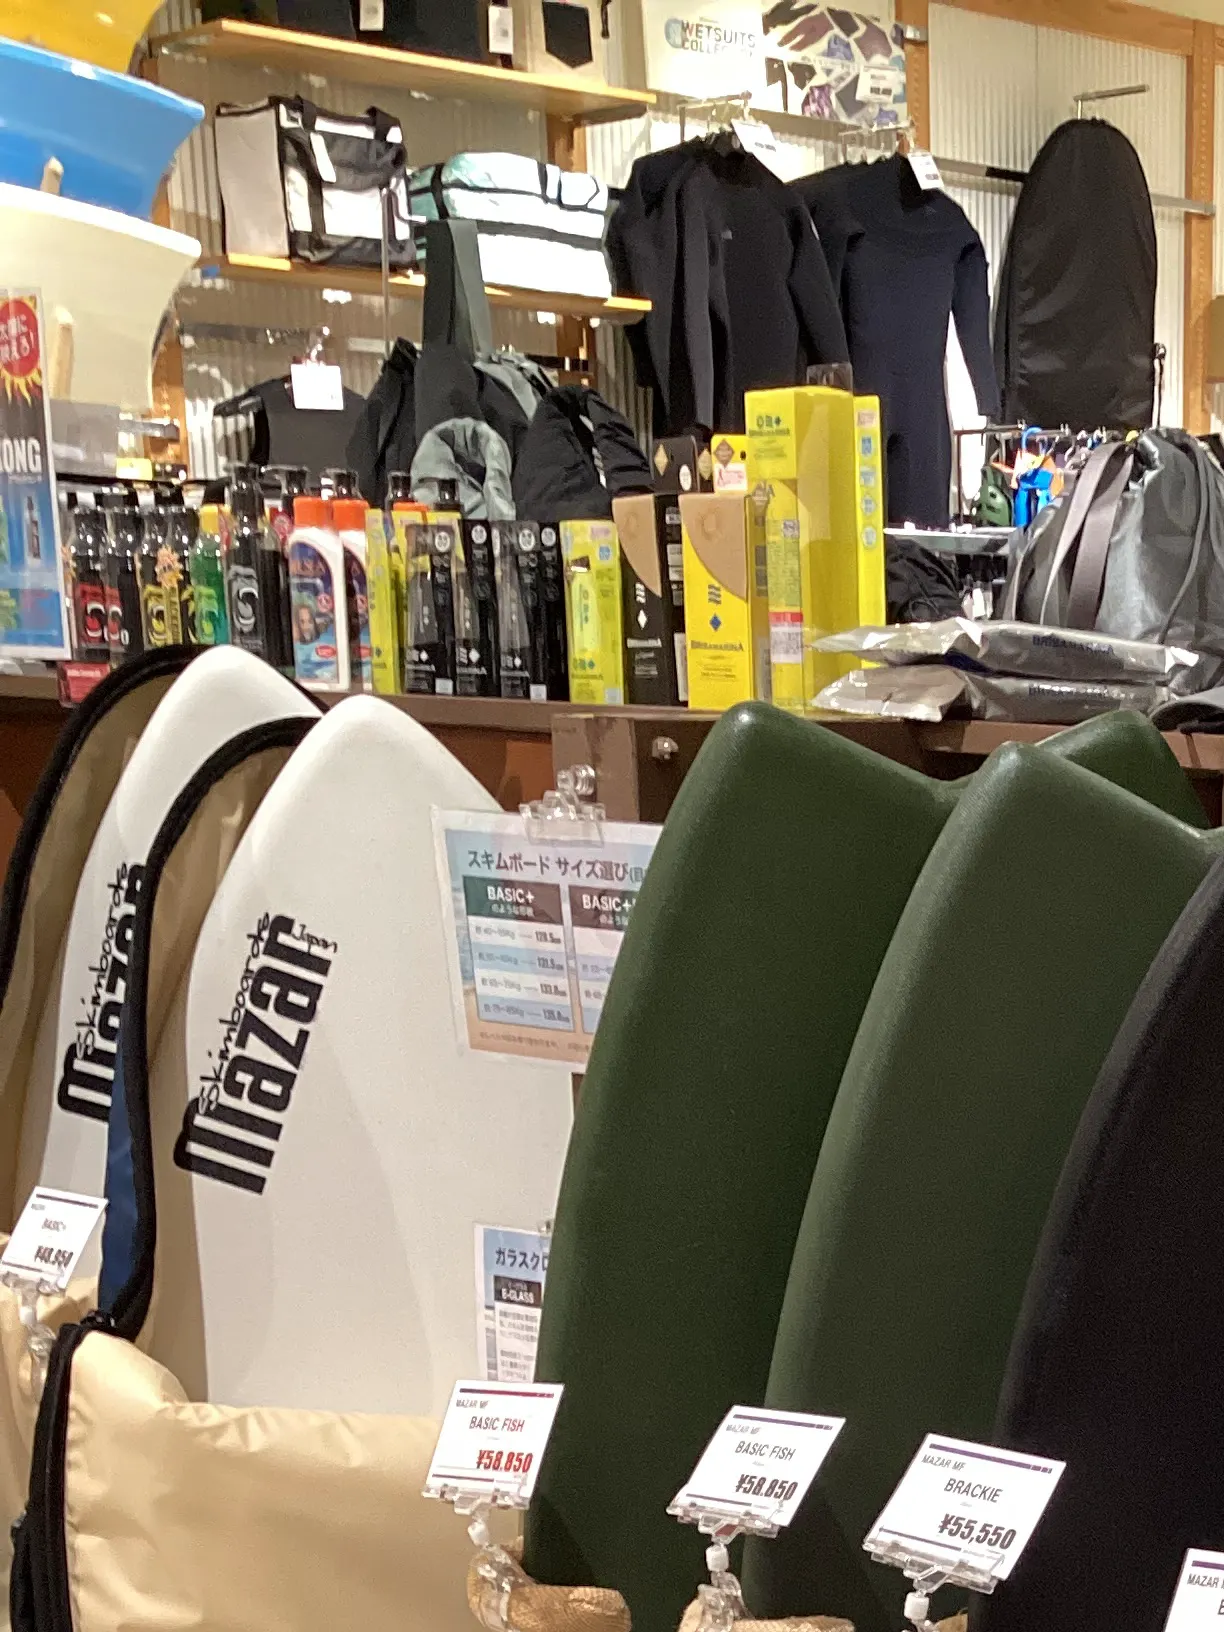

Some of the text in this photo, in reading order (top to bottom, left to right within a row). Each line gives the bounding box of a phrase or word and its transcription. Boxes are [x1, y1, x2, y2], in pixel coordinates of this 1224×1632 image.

[680, 20, 756, 49] WETSUITS
[467, 849, 550, 877] スキムボード
[487, 886, 535, 906] BASIC+
[469, 1416, 525, 1432] BASIC FISH
[735, 1440, 797, 1461] BASIC FISH
[921, 1454, 966, 1471] MAZAR MF
[943, 1477, 1003, 1503] BRACKIE
[938, 1513, 1017, 1550] ¥55,550
[1187, 1573, 1219, 1589] MAZAR
